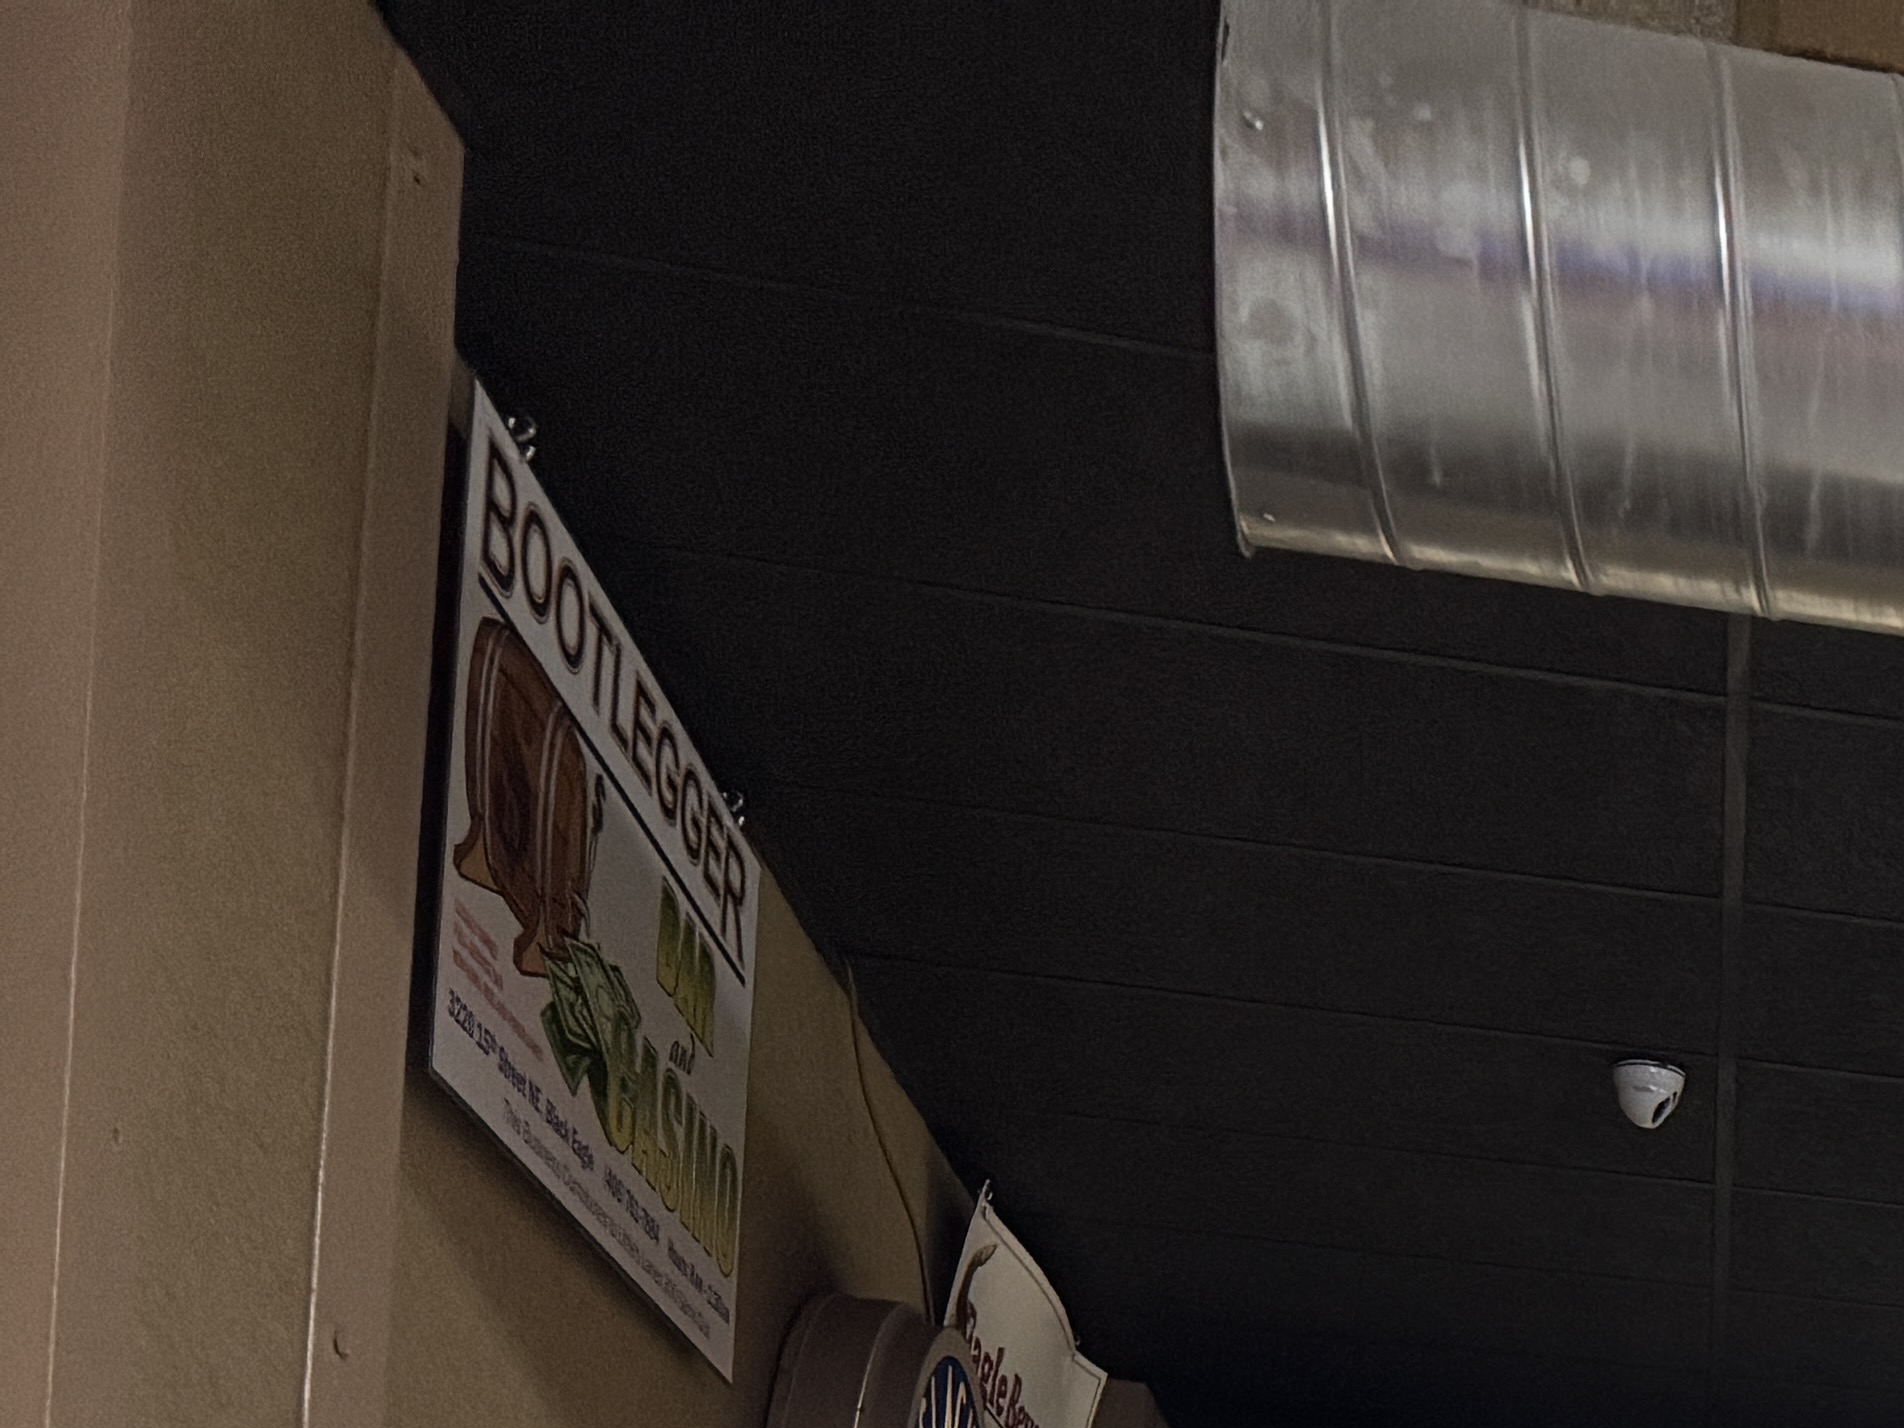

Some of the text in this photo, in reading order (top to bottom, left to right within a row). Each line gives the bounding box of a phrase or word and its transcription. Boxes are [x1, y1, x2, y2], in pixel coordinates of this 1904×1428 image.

[480, 432, 748, 970] BOOTLEGGER
[655, 873, 716, 1059] BAR
[602, 1012, 739, 1280] CASINO
